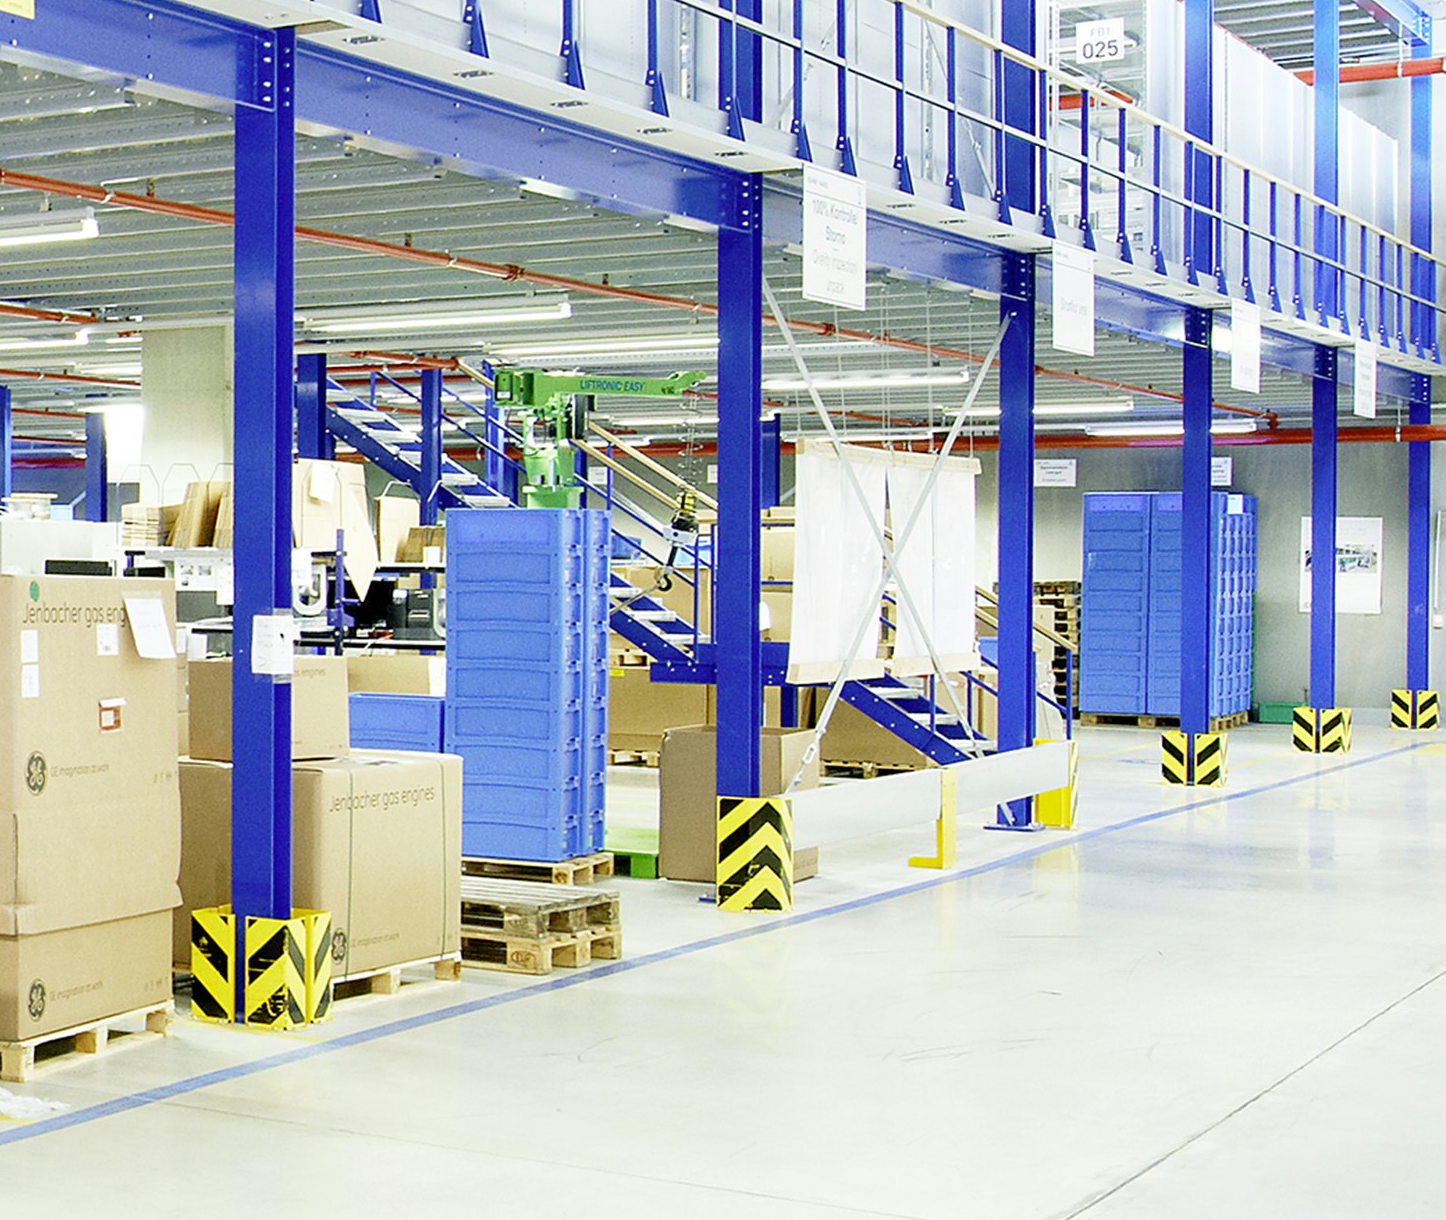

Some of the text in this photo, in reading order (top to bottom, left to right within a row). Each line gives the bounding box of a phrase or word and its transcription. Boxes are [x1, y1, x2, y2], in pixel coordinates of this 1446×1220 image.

[1083, 39, 1119, 59] 025
[580, 379, 645, 392] LIFTRONIC EASY
[22, 601, 82, 624] Jenbacher
[85, 606, 106, 628] gas
